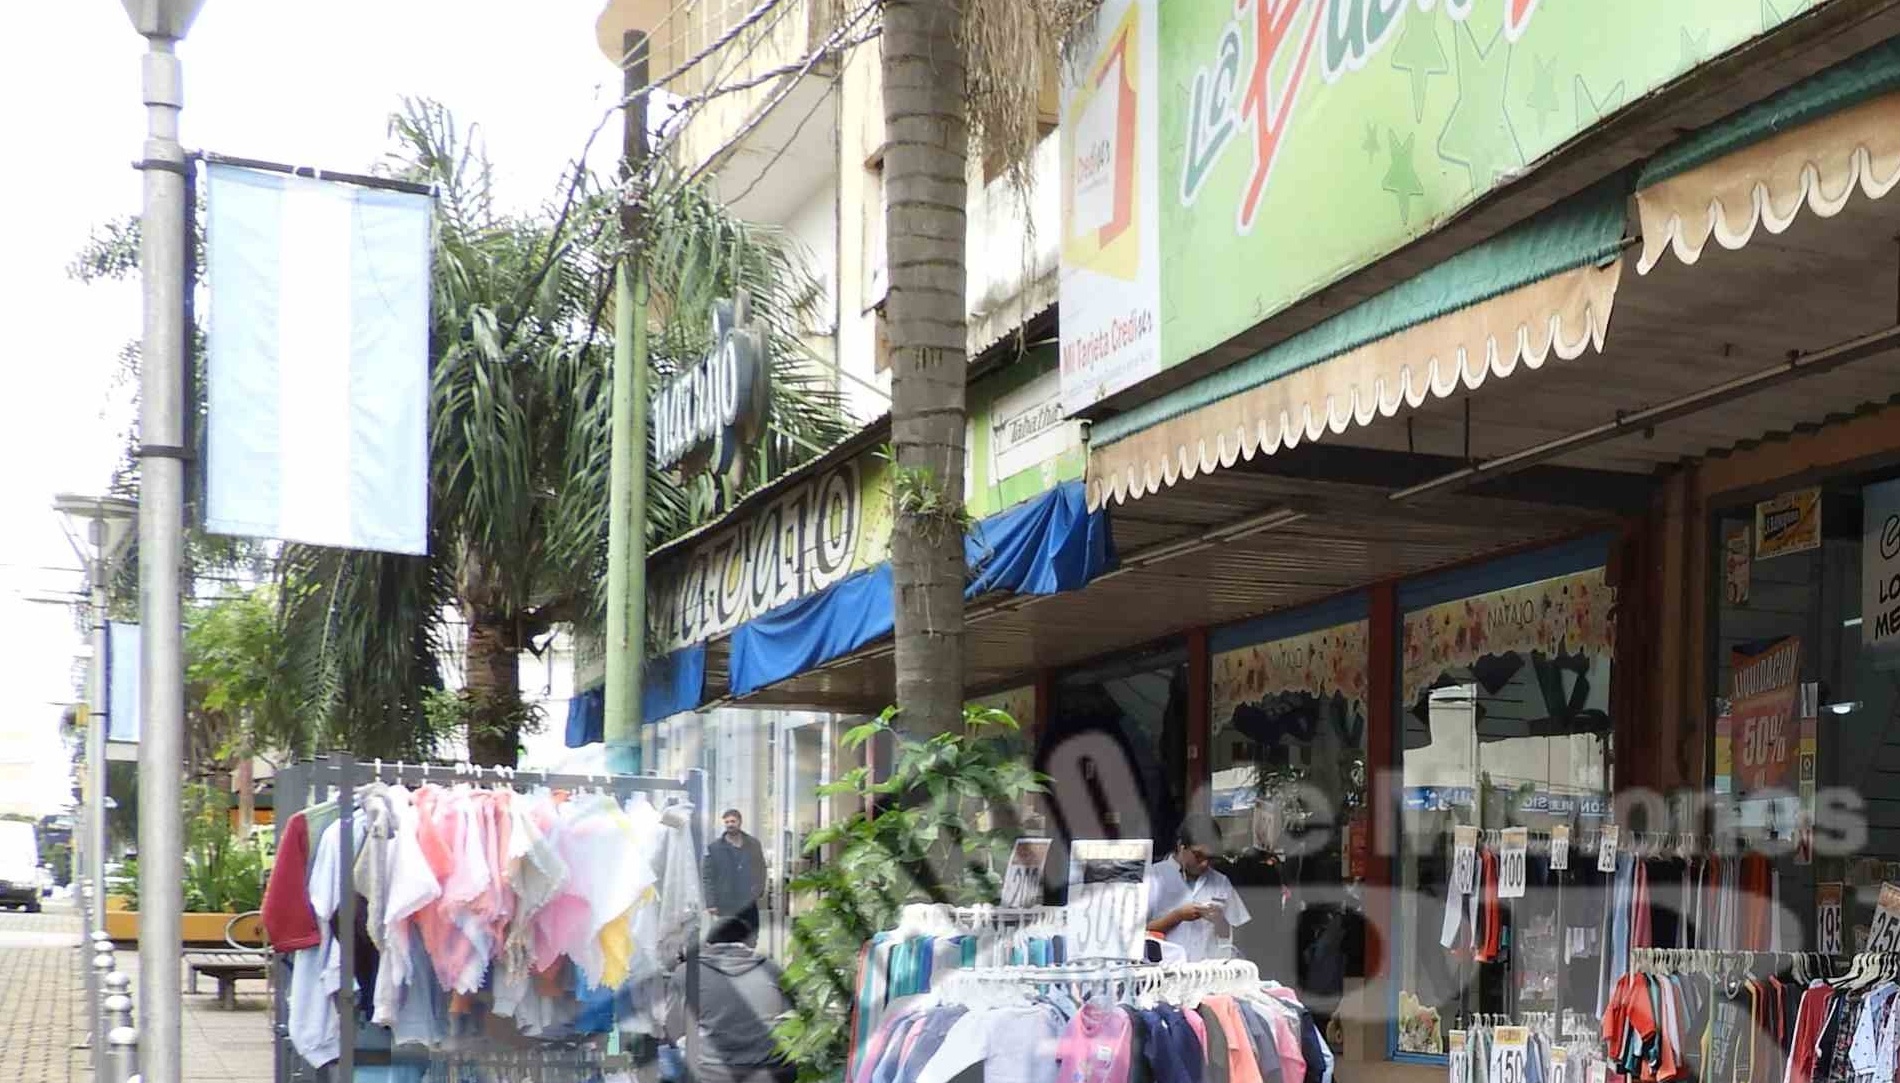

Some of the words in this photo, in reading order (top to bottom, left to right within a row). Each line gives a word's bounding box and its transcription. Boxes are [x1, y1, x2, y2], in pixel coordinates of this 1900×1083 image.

[1742, 712, 1788, 767] 50%
[1503, 851, 1525, 888] 100
[1076, 884, 1140, 952] 300
